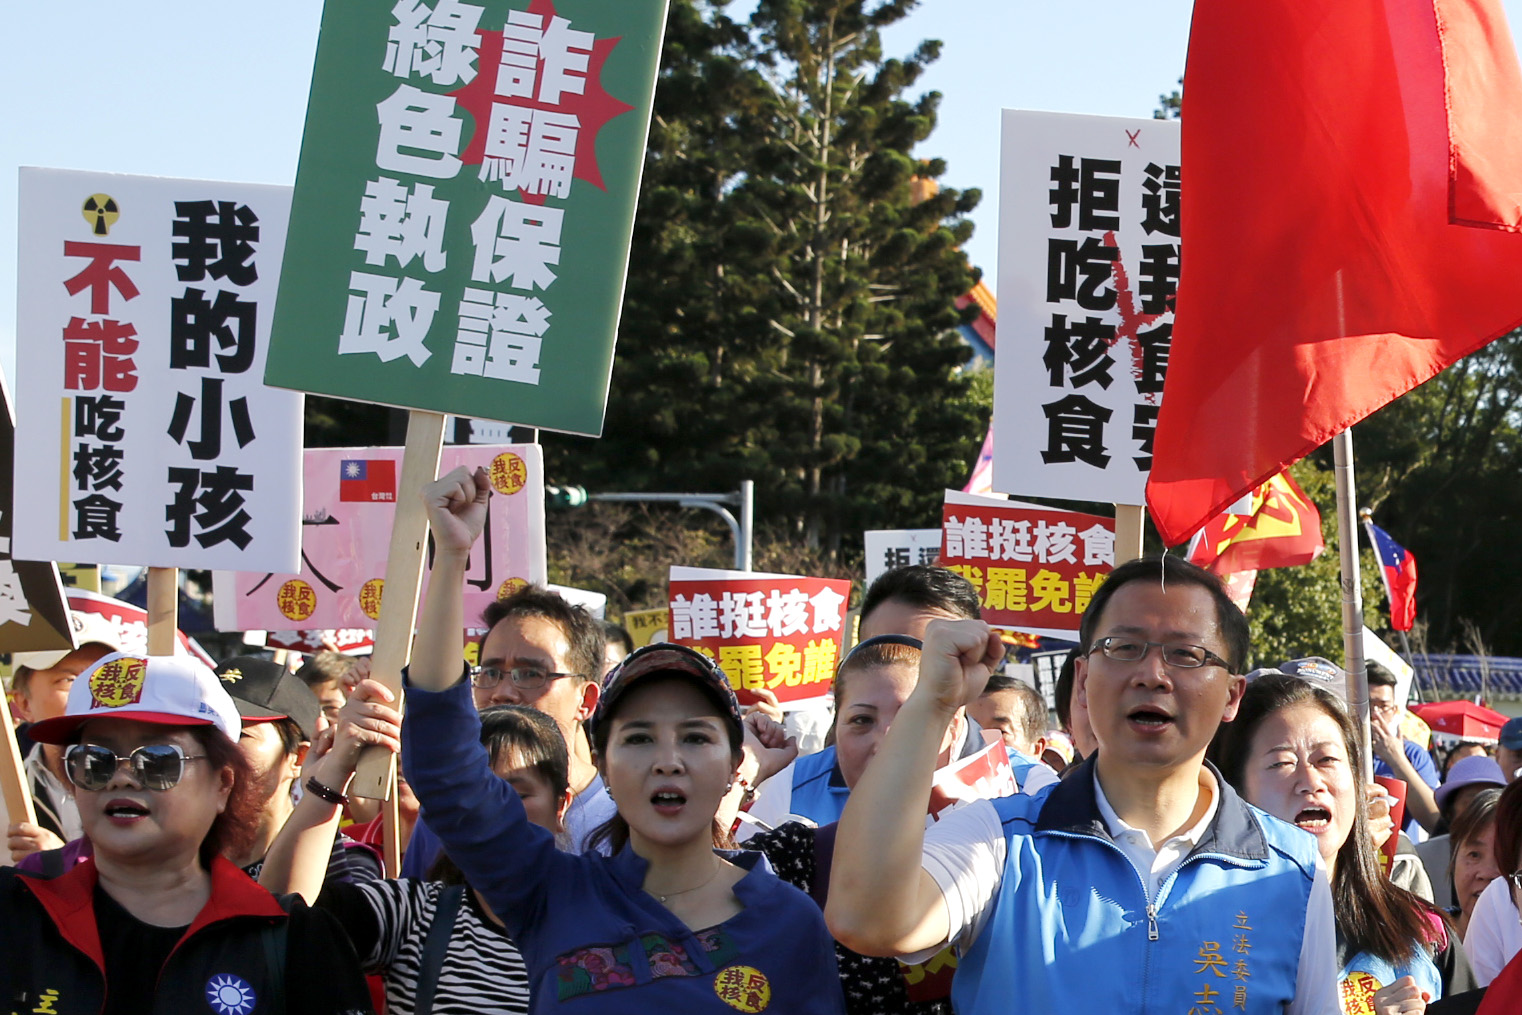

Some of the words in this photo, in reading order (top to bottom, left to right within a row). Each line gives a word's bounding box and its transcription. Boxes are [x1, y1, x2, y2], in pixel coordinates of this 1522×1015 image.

[338, 0, 482, 368] 綠色執政
[450, 9, 595, 387] 詐騙保證
[1041, 155, 1121, 470] 拒吃核食
[166, 200, 260, 551] 我的小孩
[670, 586, 845, 640] 誰挺核食
[944, 515, 1116, 567] 誰挺核食
[1231, 910, 1253, 1011] 立法委員
